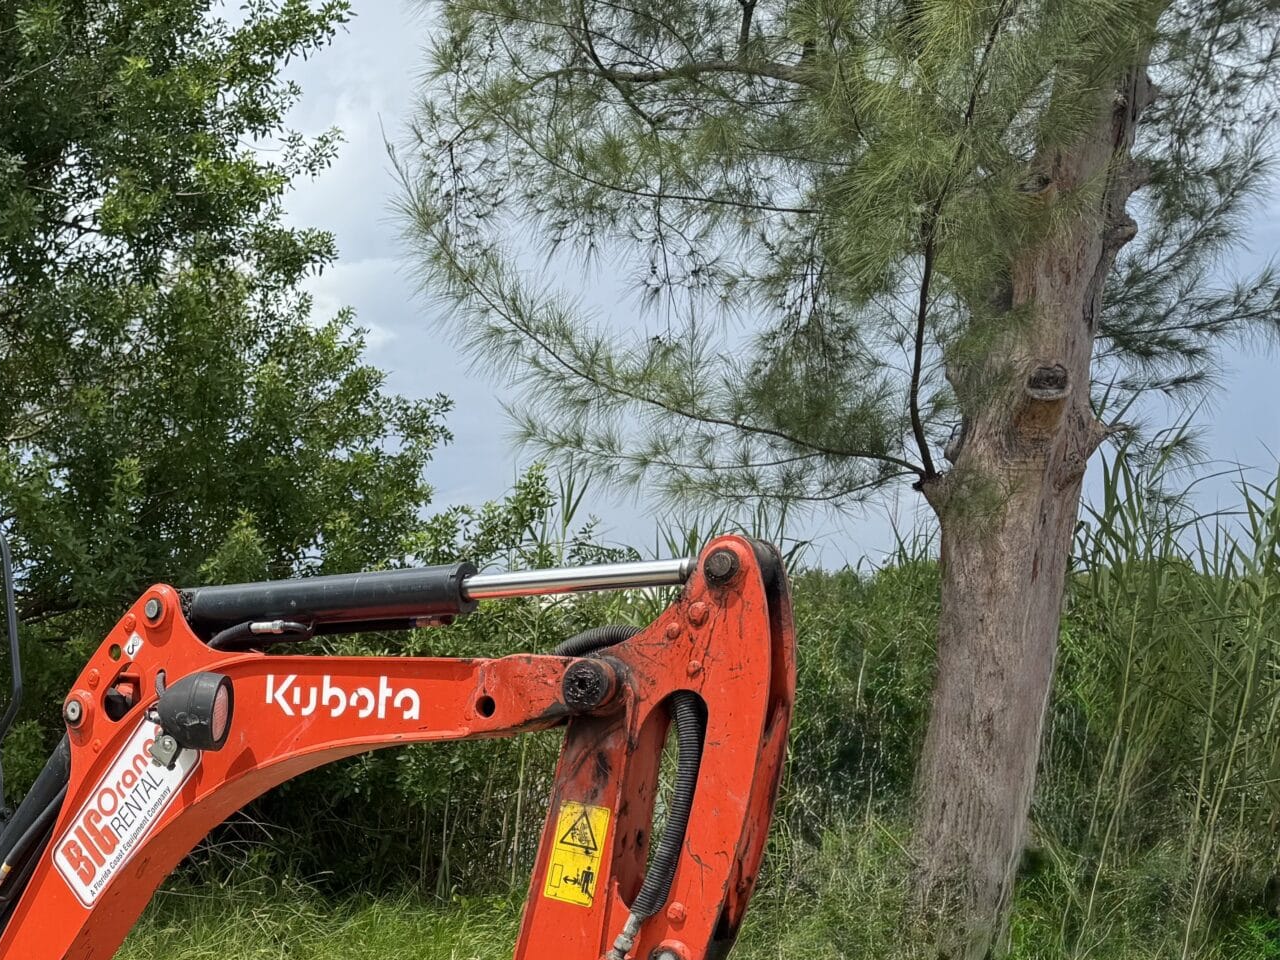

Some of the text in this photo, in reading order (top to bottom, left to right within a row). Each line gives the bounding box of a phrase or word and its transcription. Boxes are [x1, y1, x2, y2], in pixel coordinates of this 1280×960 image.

[265, 674, 420, 720] Kubota
[61, 725, 163, 886] BIG Oran
[90, 786, 172, 897] A Florida Coast Equipment Company
[110, 771, 163, 838] RENTAL
